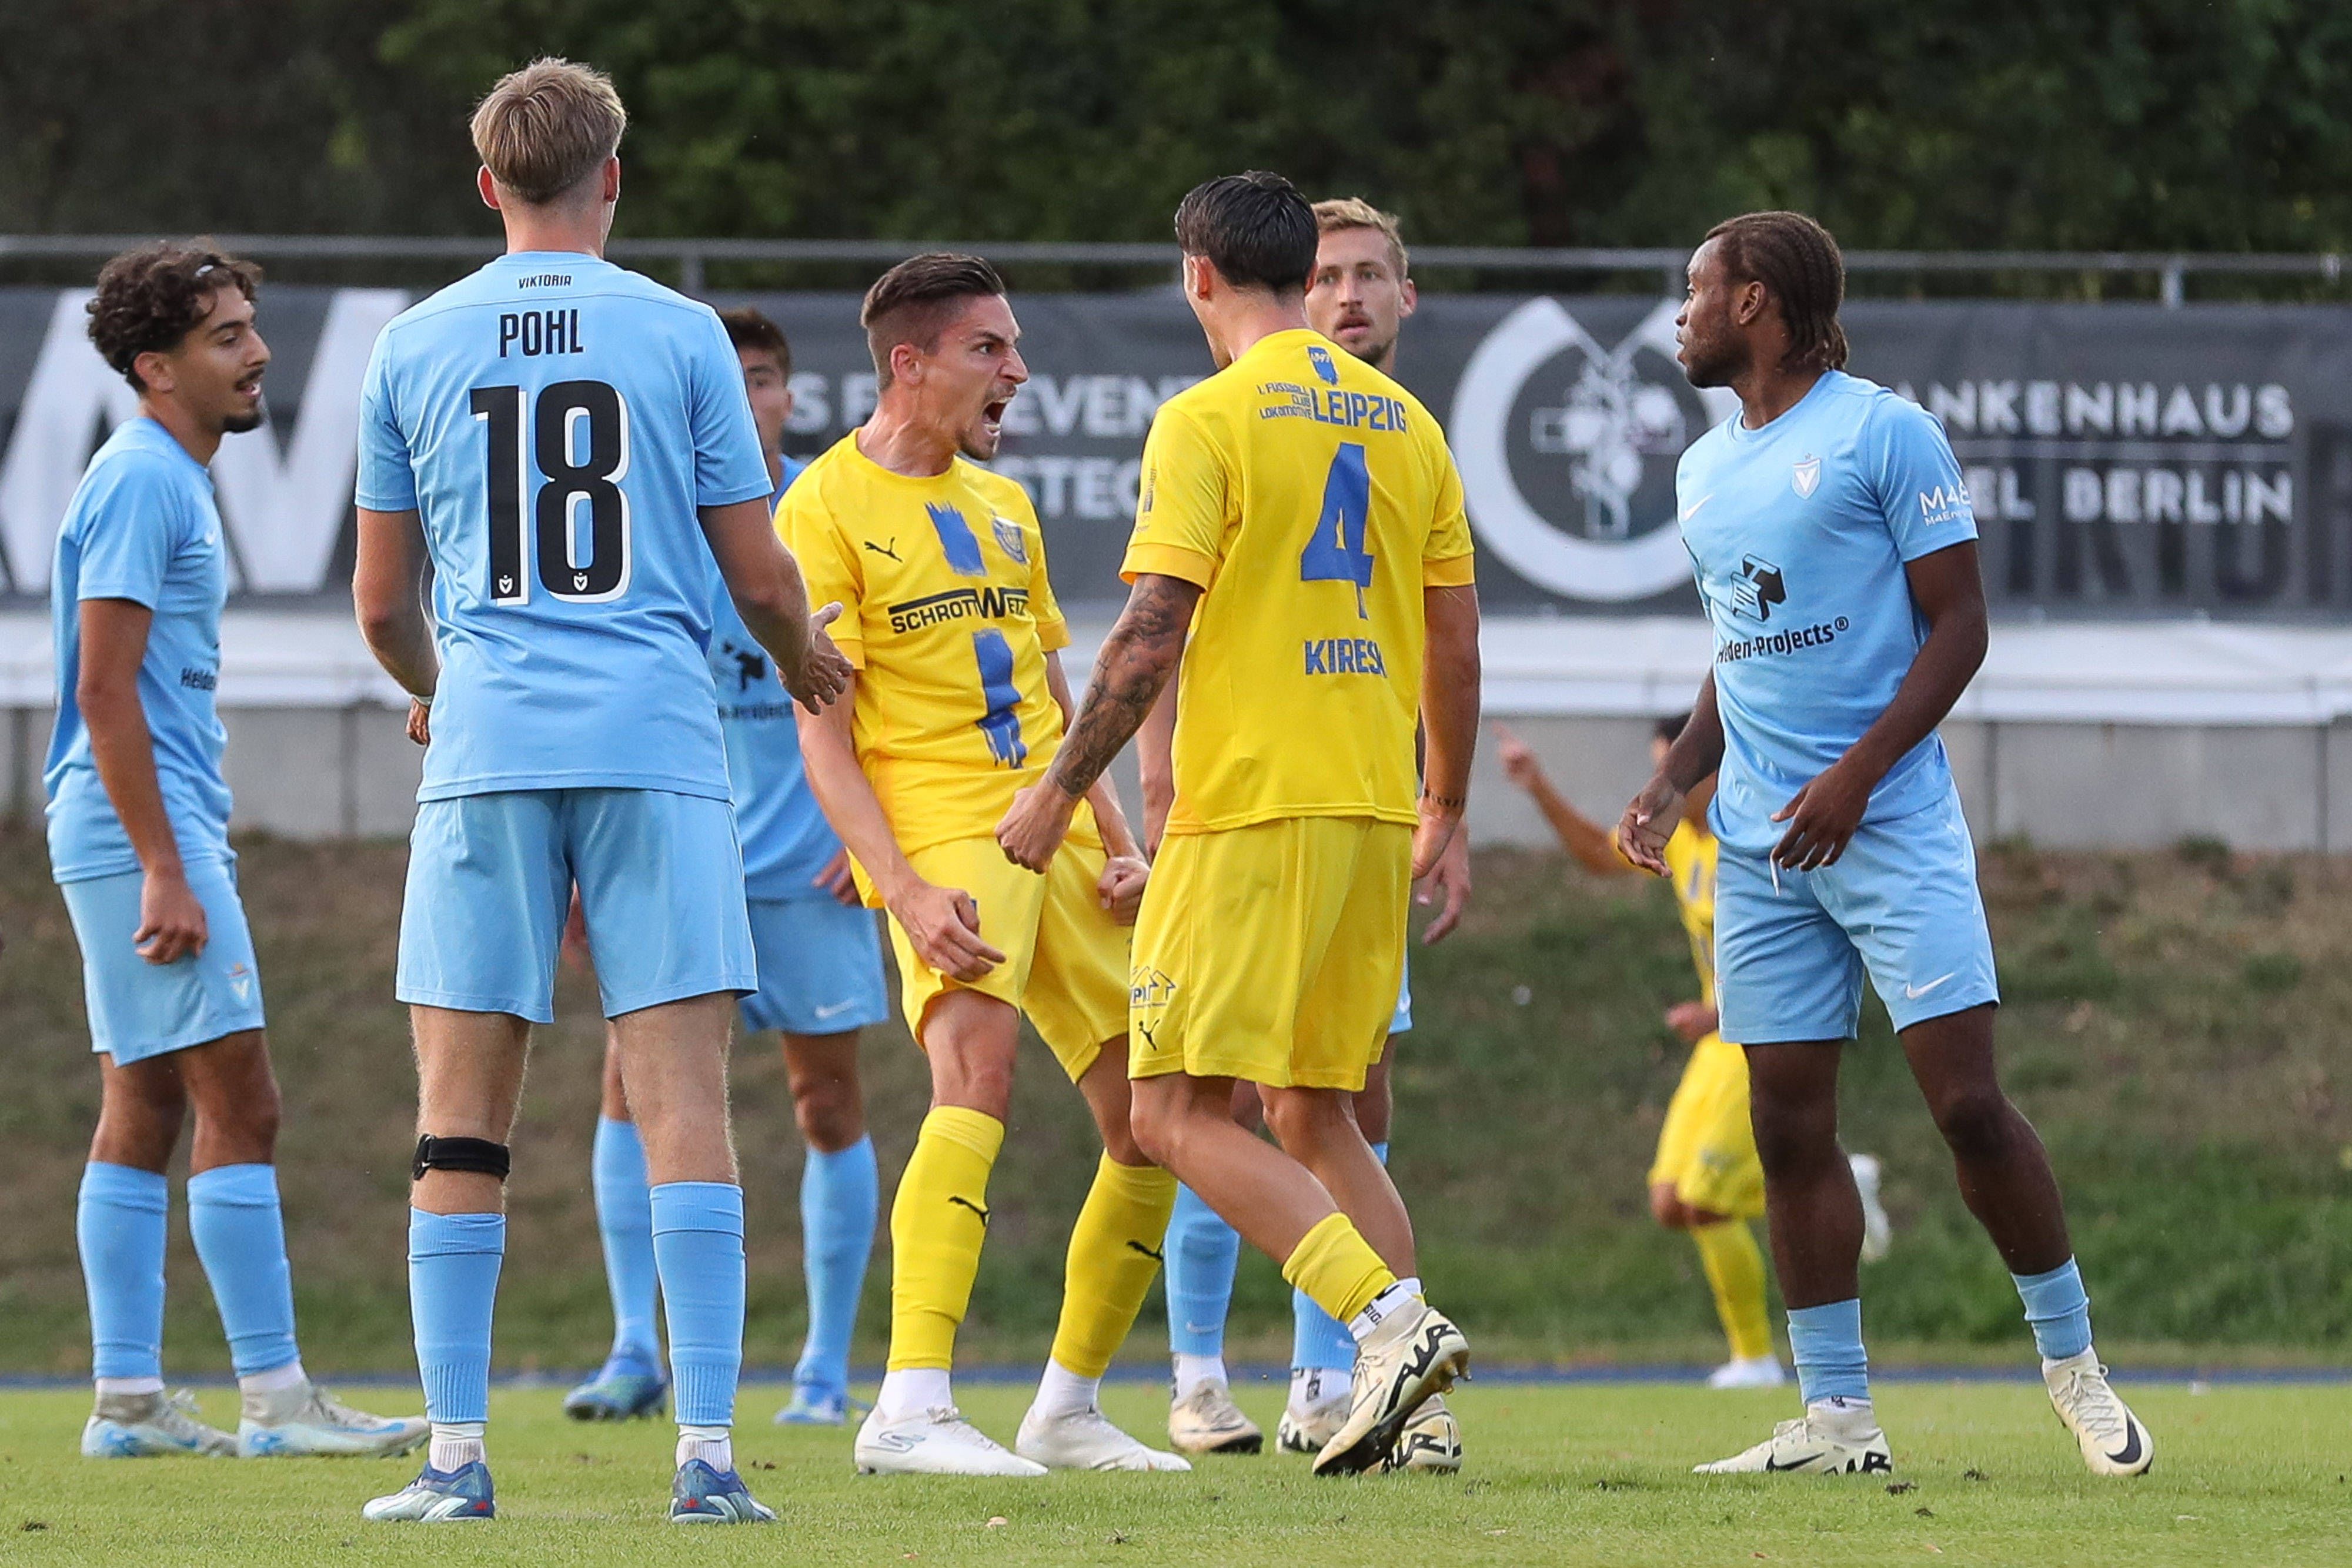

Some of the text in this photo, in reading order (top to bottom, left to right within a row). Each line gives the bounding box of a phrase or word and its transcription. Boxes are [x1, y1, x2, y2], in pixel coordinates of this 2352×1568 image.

[519, 275, 572, 289] VIKTORIA
[499, 308, 584, 358] POHL
[1311, 387, 1407, 433] LEIPZIG
[470, 379, 630, 605] 18
[1301, 442, 1374, 589] 4
[2063, 467, 2293, 524] BERLIN
